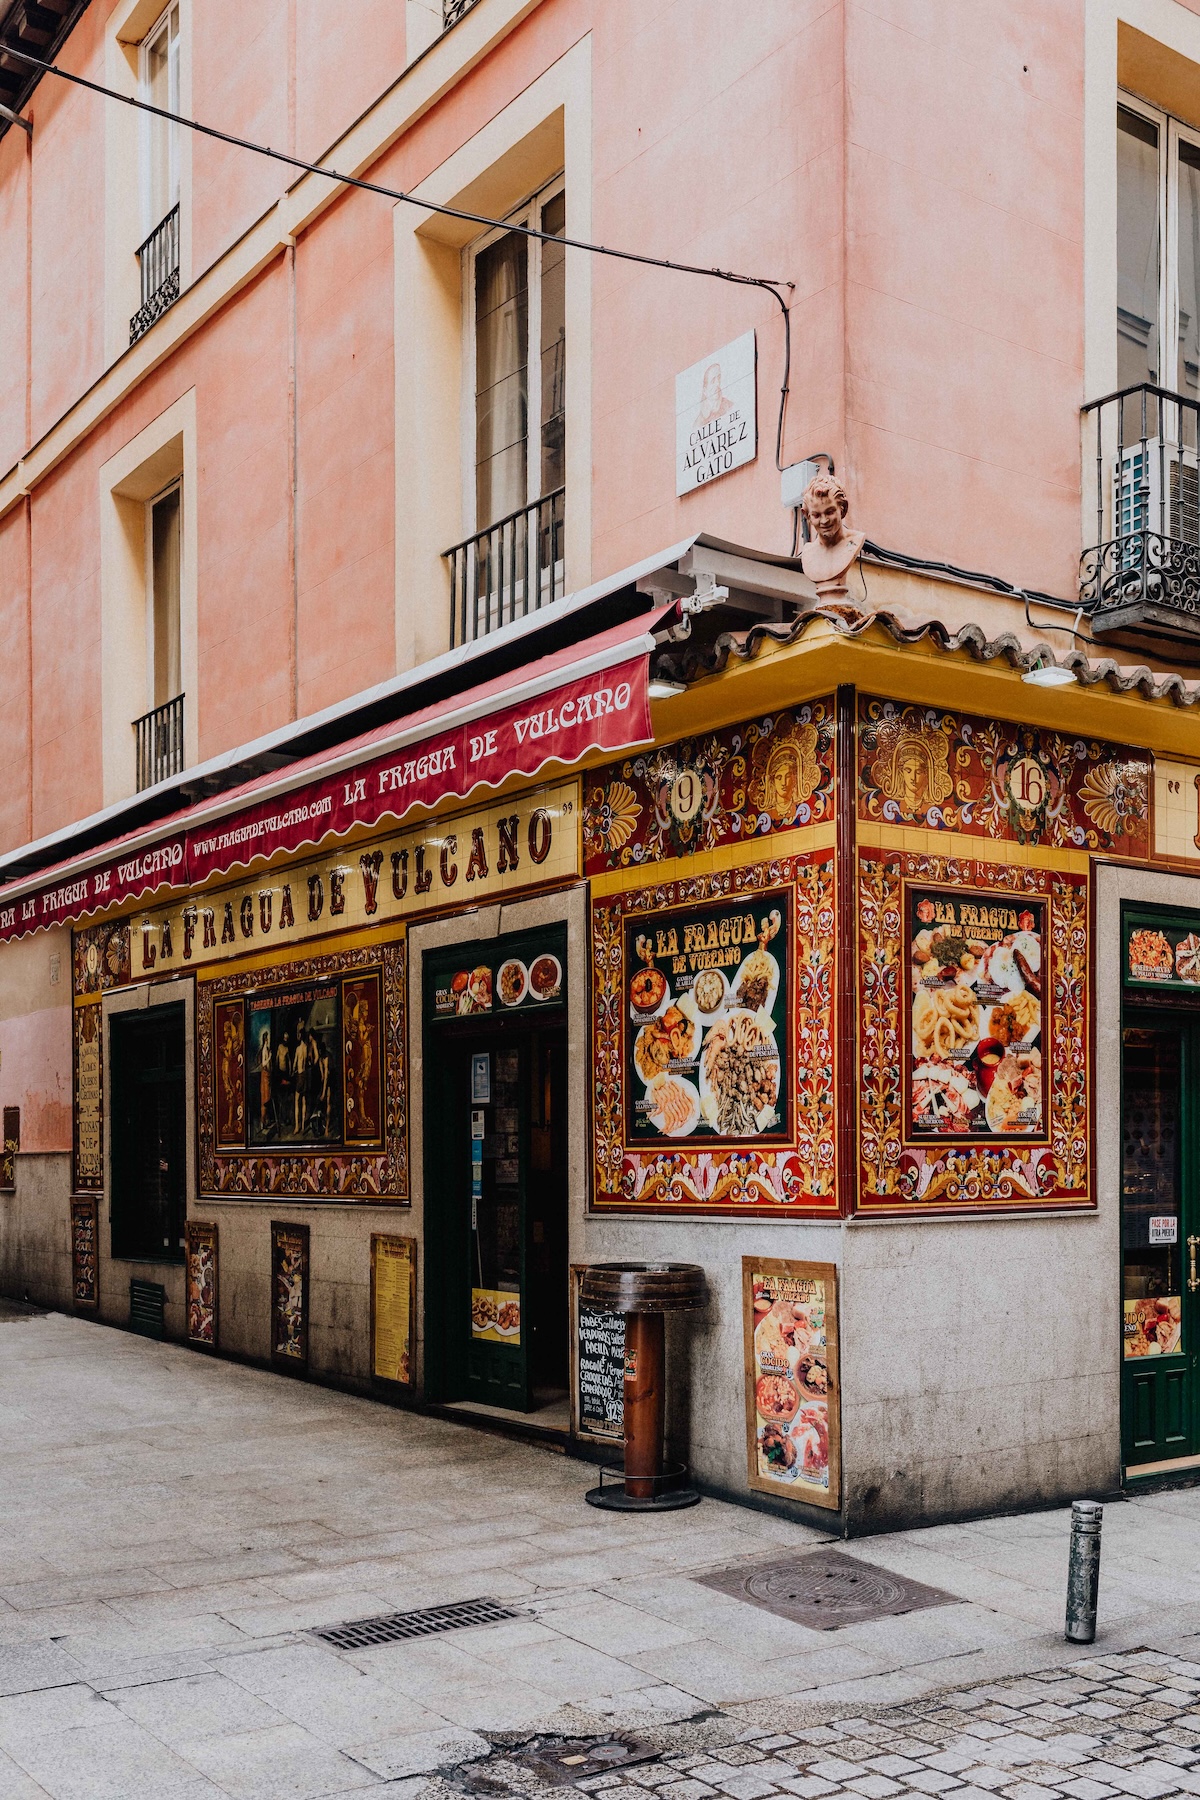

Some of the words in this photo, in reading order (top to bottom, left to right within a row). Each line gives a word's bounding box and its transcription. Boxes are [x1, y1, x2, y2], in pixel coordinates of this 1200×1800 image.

[689, 418, 722, 446] CALLE
[729, 409, 741, 424] DE
[682, 421, 748, 472] ALVAREZ
[696, 450, 733, 483] GATO
[343, 778, 367, 806] LA
[378, 745, 457, 794] FRAGUA
[469, 729, 498, 763] DE
[513, 682, 631, 744] VULCANO
[677, 773, 695, 814] 9
[1013, 760, 1043, 806] 16
[22, 899, 36, 921] LA
[42, 879, 88, 914] FRAGUA
[94, 870, 112, 895] DE
[117, 843, 184, 885] VULCANO
[181, 884, 295, 960] FRAGUA
[307, 868, 346, 922] DE
[934, 901, 957, 924] LA
[959, 903, 1019, 930] FRAGUA
[655, 927, 679, 958] LA
[683, 913, 757, 953] FRAGUA
[950, 924, 962, 938] DE
[963, 925, 1003, 941] VULCANO
[672, 955, 687, 975] DE
[689, 946, 741, 972] VULCANO
[85, 1137, 93, 1149] DE
[1151, 1219, 1161, 1228] PASE
[1161, 1219, 1170, 1228] POR
[1170, 1219, 1176, 1228] LA
[762, 1276, 776, 1290] LA
[777, 1277, 817, 1295] FRAGUA
[770, 1290, 779, 1300] DE
[580, 1315, 603, 1330] FABES
[760, 1356, 789, 1368] COCIDO
